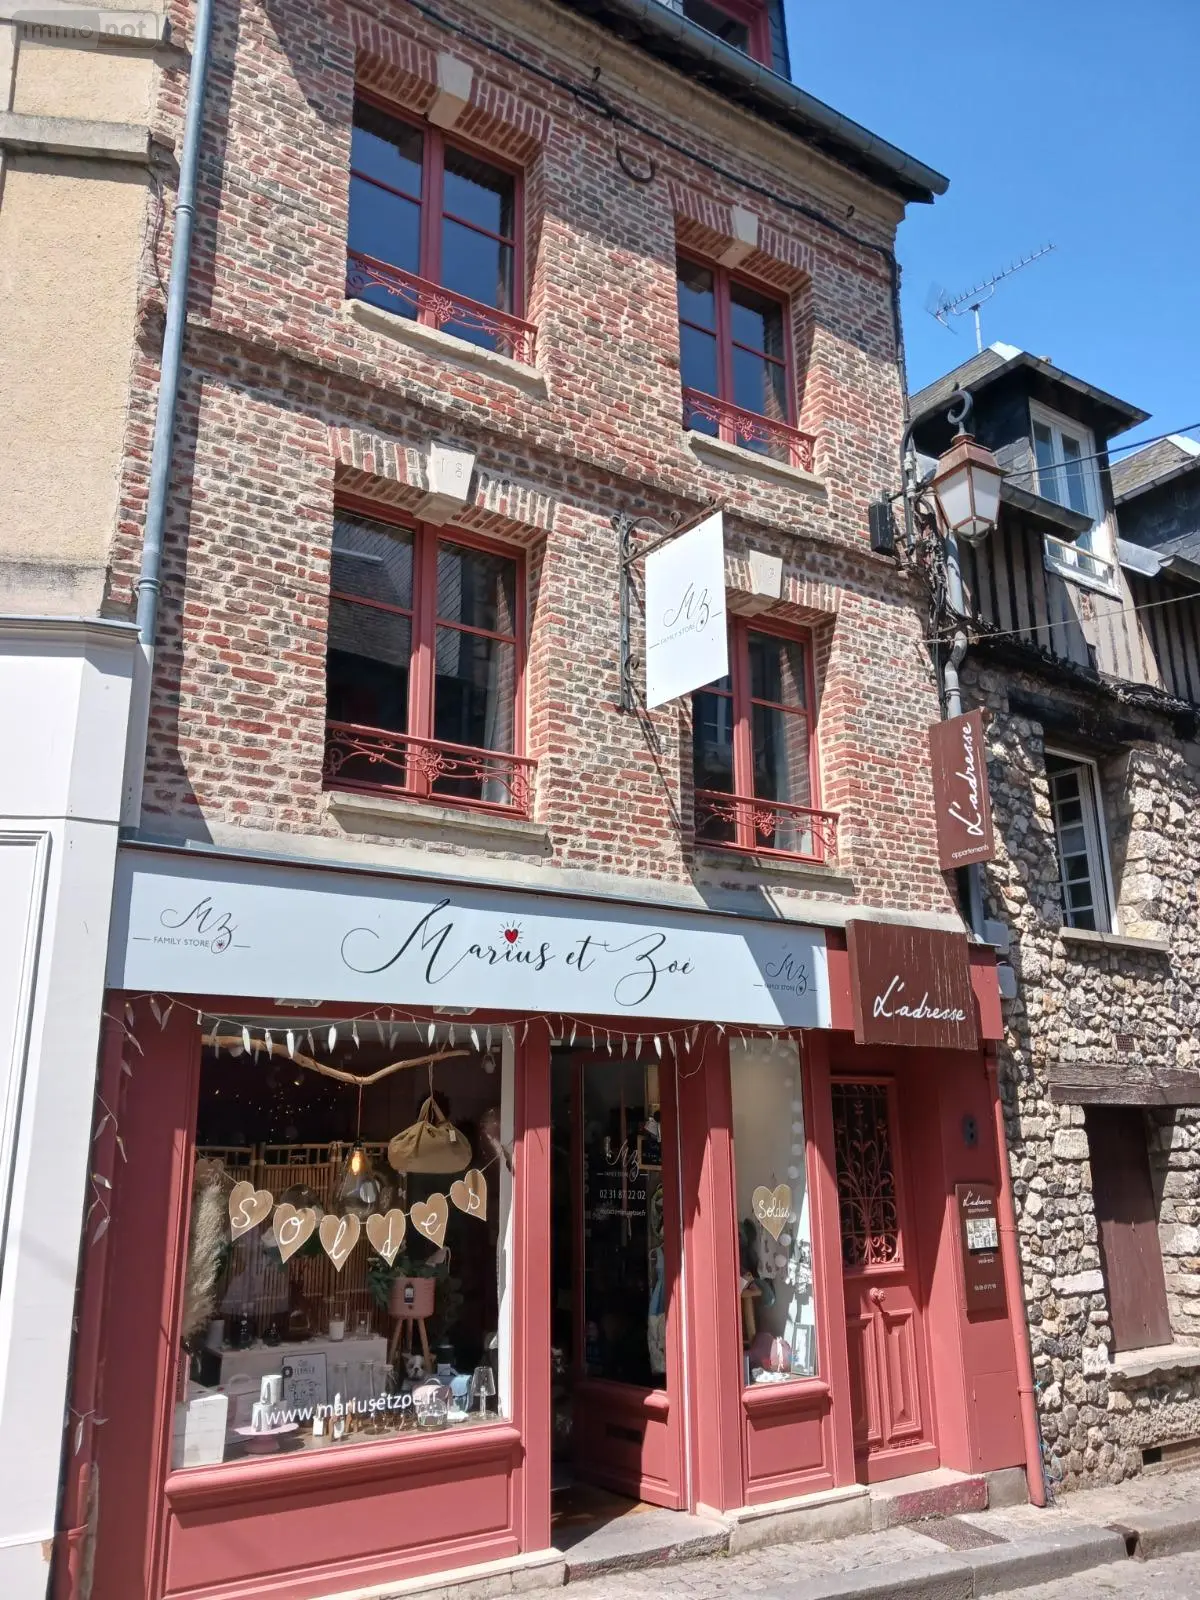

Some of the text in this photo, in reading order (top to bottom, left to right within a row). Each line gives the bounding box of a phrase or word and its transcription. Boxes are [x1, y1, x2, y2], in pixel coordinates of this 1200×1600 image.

[948, 721, 985, 836] L'adresse
[153, 936, 210, 948] FAMILY STORE
[341, 897, 555, 985] Marius
[565, 935, 607, 972] et
[873, 975, 967, 1022] L'adresse
